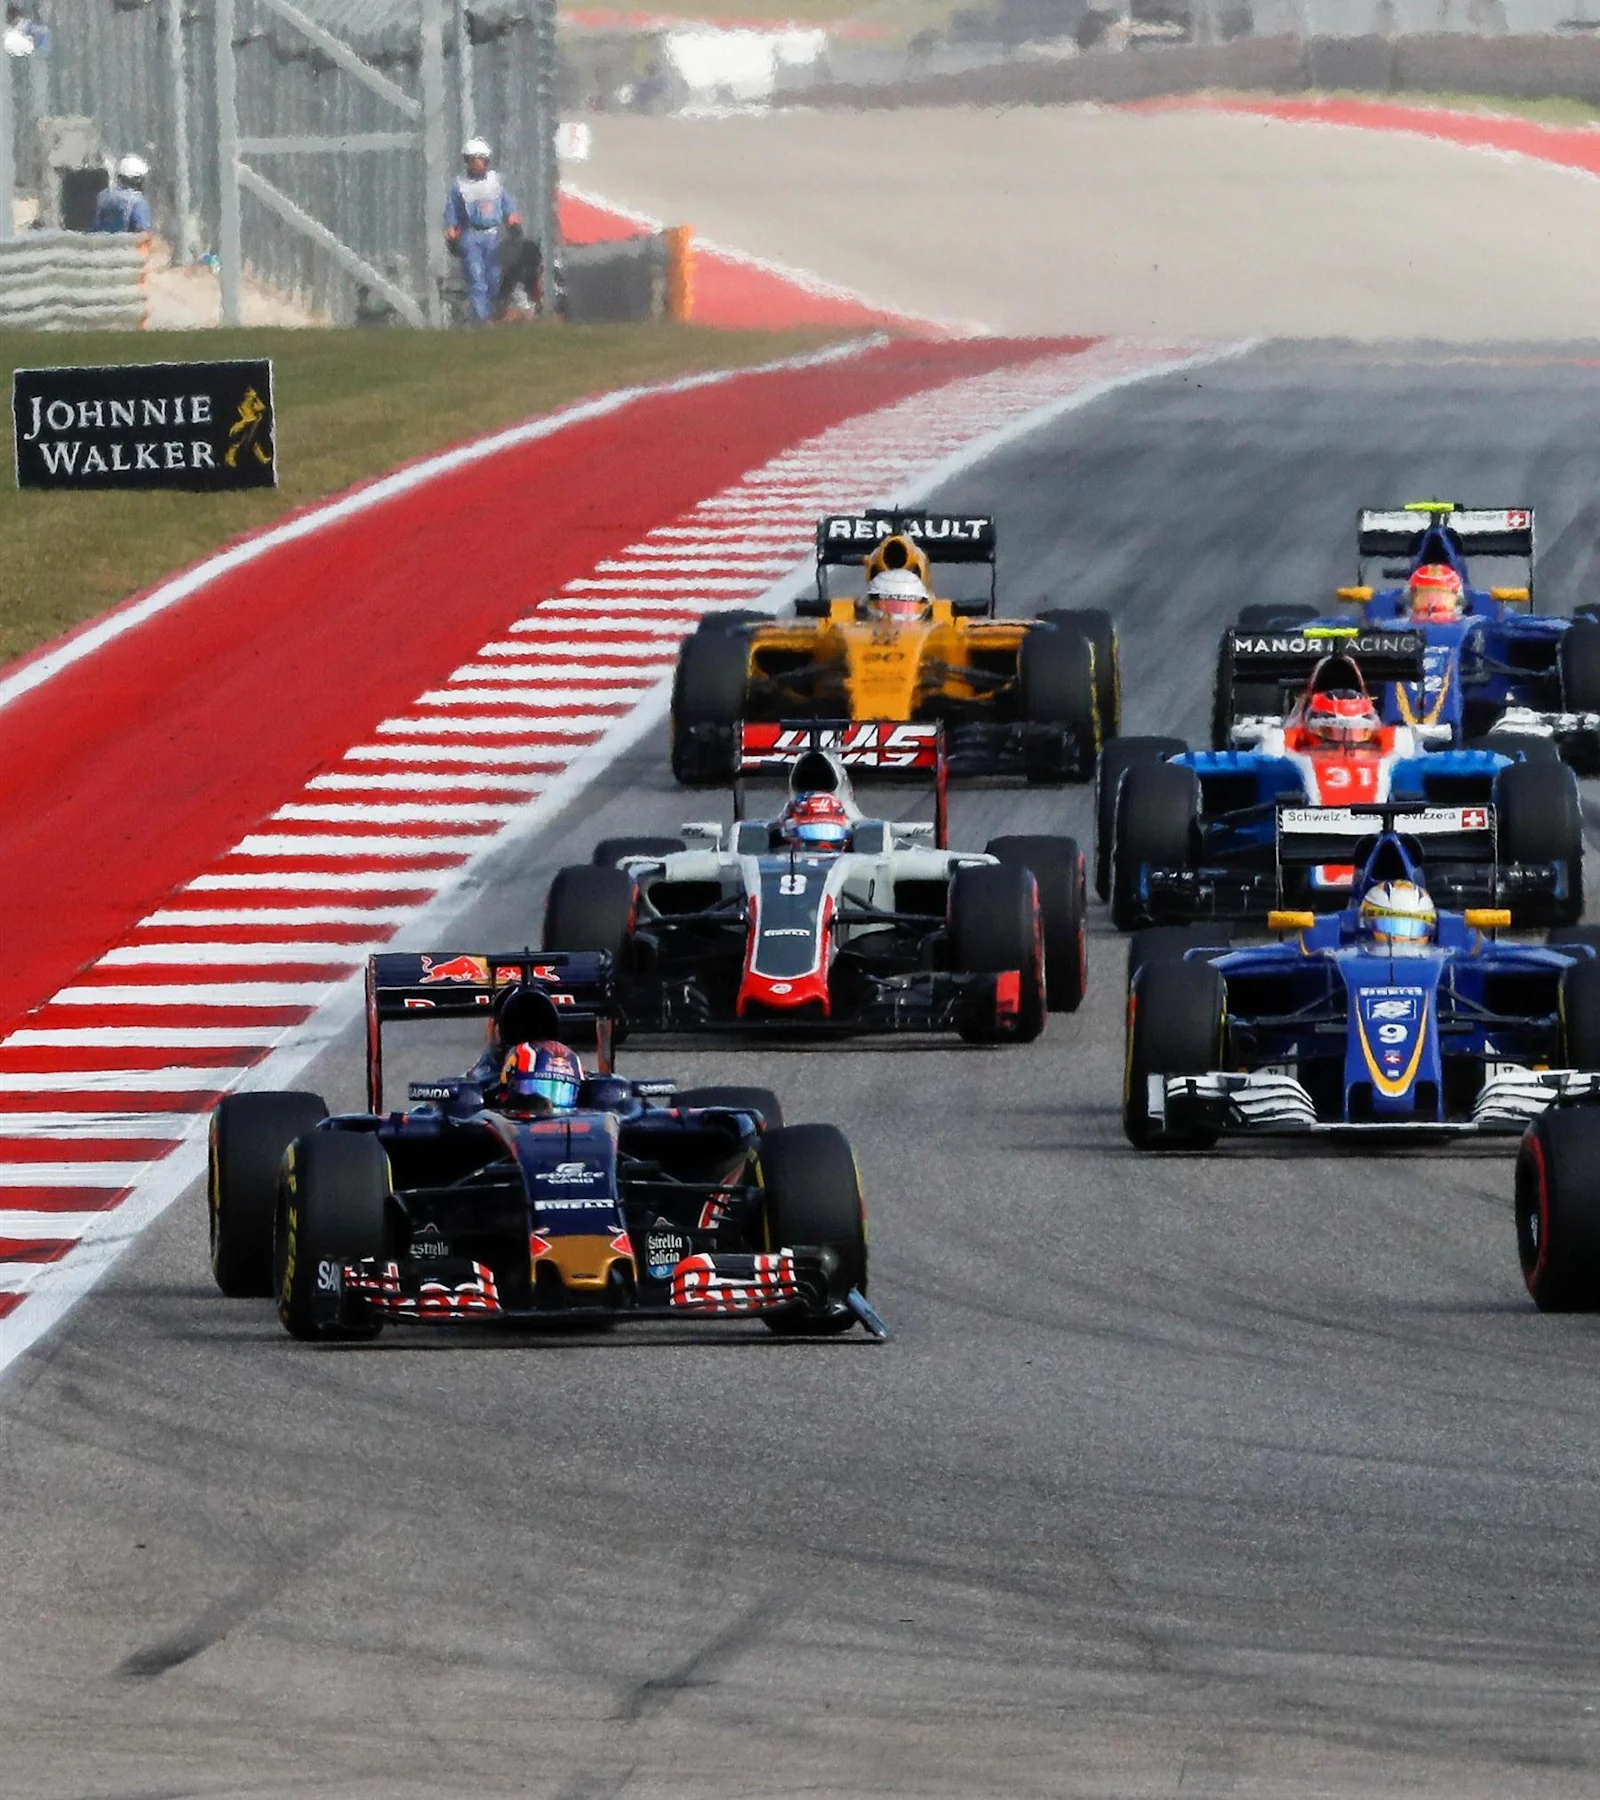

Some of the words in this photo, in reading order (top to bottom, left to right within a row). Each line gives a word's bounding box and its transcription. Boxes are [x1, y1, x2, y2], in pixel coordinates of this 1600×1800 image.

[24, 396, 212, 440] JOHNNIE
[39, 441, 216, 475] WALKER
[829, 519, 988, 539] RENAULT
[1235, 638, 1322, 653] MANOR
[1325, 767, 1373, 787] 31
[1378, 1024, 1408, 1044] 9
